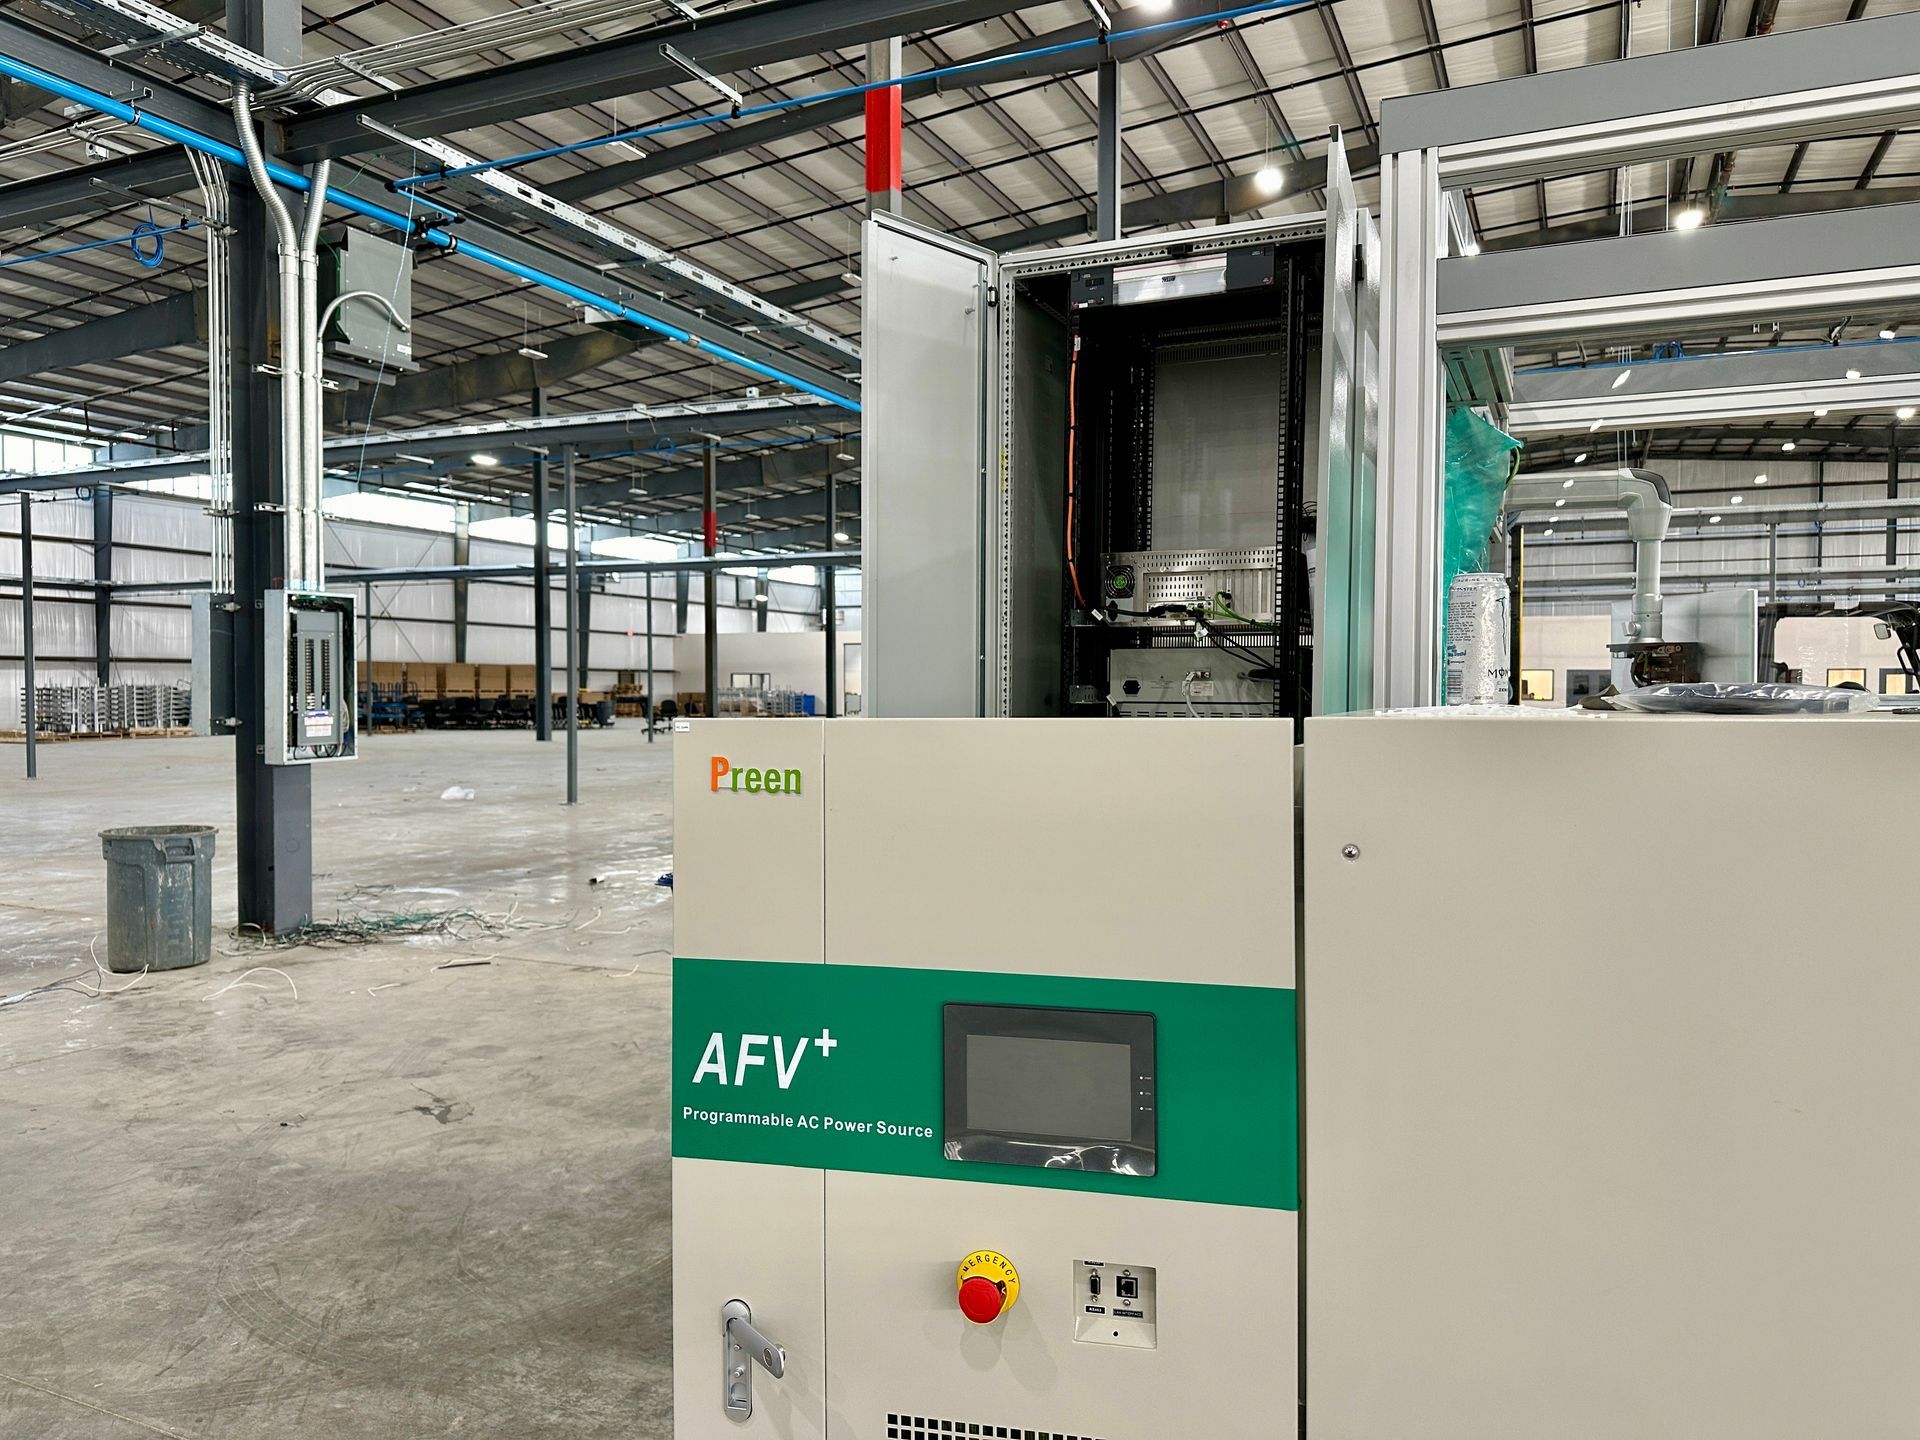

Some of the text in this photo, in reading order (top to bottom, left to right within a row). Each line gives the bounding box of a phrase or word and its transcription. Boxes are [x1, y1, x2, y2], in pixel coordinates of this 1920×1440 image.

[711, 756, 801, 794] Preen
[683, 1106, 933, 1138] Programmable AC Power Source
